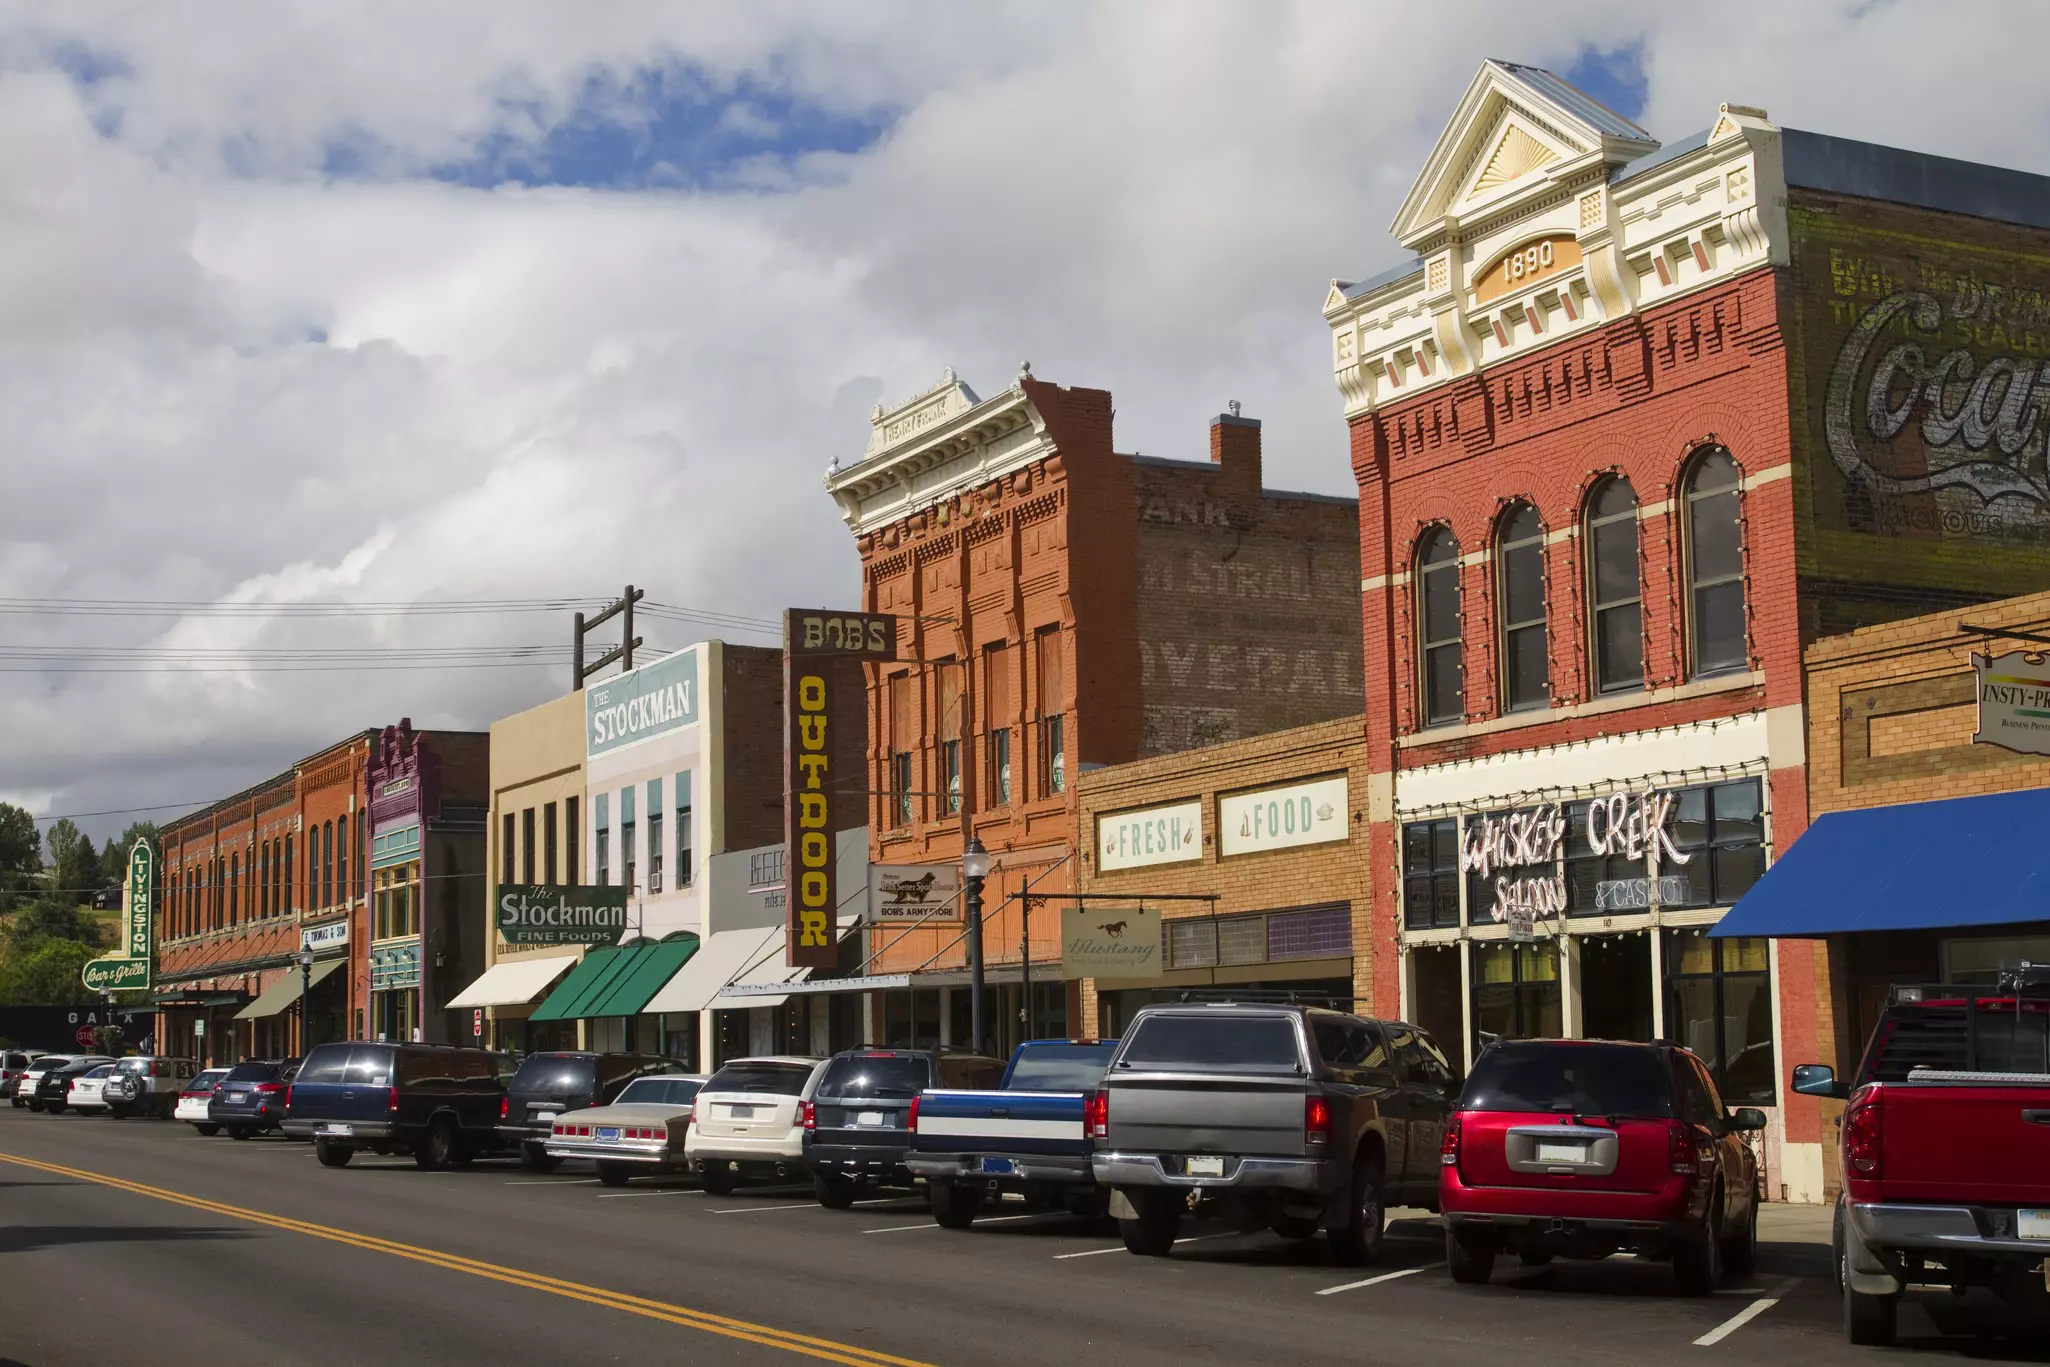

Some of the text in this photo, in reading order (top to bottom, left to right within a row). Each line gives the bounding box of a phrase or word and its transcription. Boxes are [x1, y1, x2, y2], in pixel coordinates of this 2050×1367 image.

[1503, 241, 1554, 282] 1890
[802, 616, 886, 652] BOB'S
[593, 690, 610, 708] THE
[594, 680, 690, 745] STOCKMAN
[799, 675, 829, 948] OUTDOOR
[1253, 796, 1313, 840] FOOD
[1119, 816, 1181, 858] FRESH
[1460, 784, 1692, 879] WHISKEY CREEK
[133, 855, 147, 953] LIVINGSTON
[501, 892, 623, 925] Stockman
[528, 886, 557, 899] The
[1490, 875, 1568, 922] SALOON
[881, 907, 953, 916] BOB'S ARMY STORE
[337, 925, 347, 937] SON
[517, 932, 611, 941] FINE FOODS
[1068, 938, 1156, 964] Mustang
[86, 967, 109, 983] Bar
[115, 963, 146, 984] Grille
[79, 1031, 93, 1041] STO
